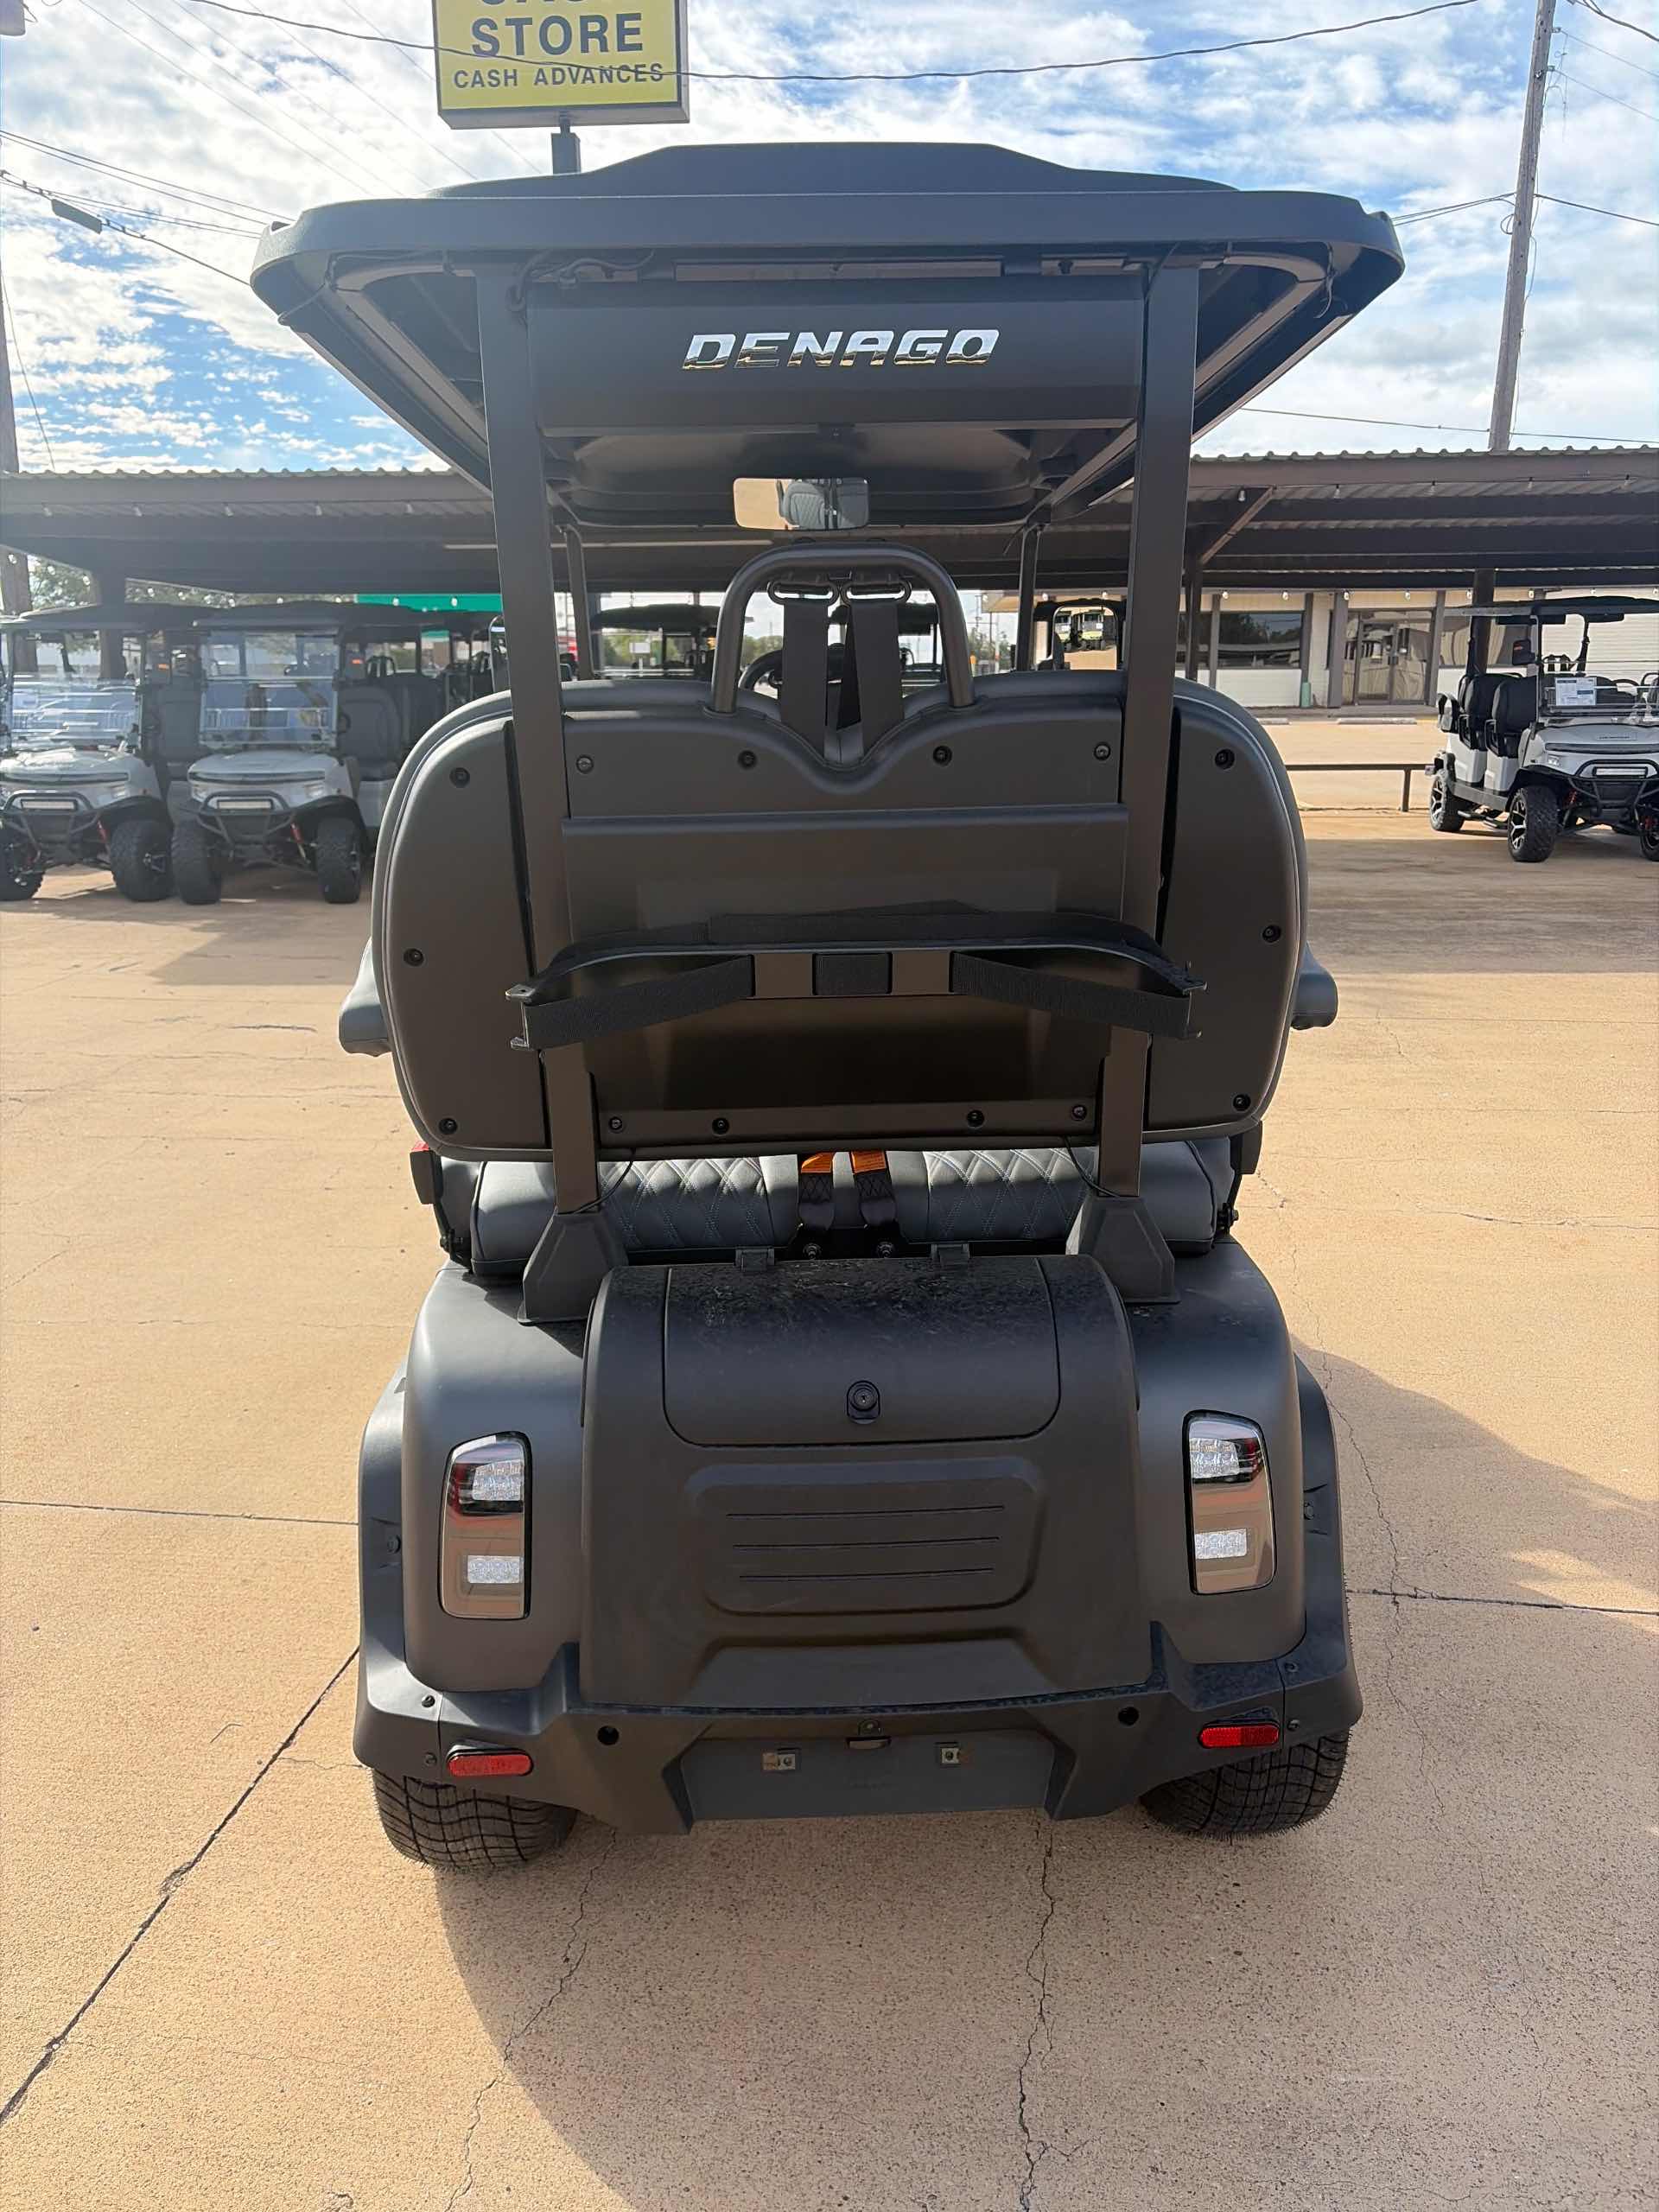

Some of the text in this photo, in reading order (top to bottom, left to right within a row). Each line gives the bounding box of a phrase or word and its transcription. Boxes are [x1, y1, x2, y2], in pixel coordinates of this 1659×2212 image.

[471, 12, 644, 57] STORE
[454, 63, 664, 89] CASH ADVANCES
[682, 329, 1001, 371] DENAGO
